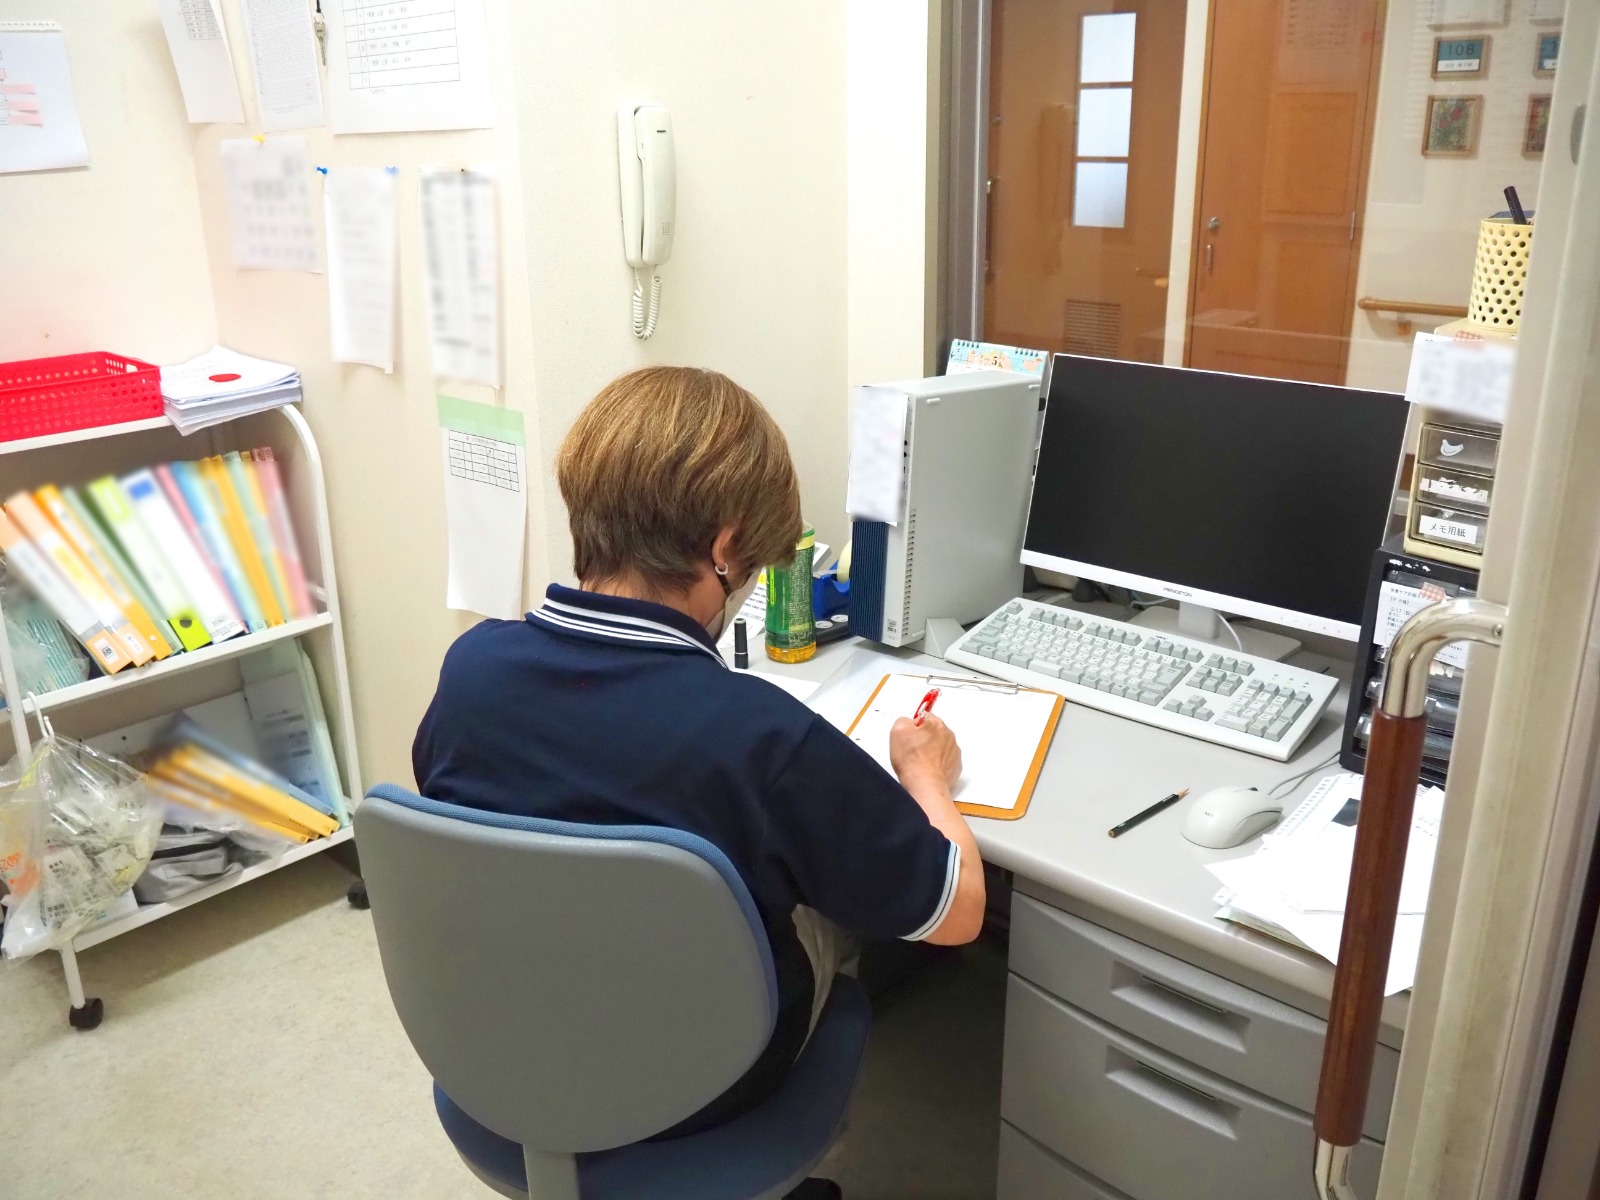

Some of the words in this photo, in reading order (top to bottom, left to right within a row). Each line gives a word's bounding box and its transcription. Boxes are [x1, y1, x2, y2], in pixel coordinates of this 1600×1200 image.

[1447, 43, 1476, 56] 108
[1430, 523, 1466, 538] メモ用紙
